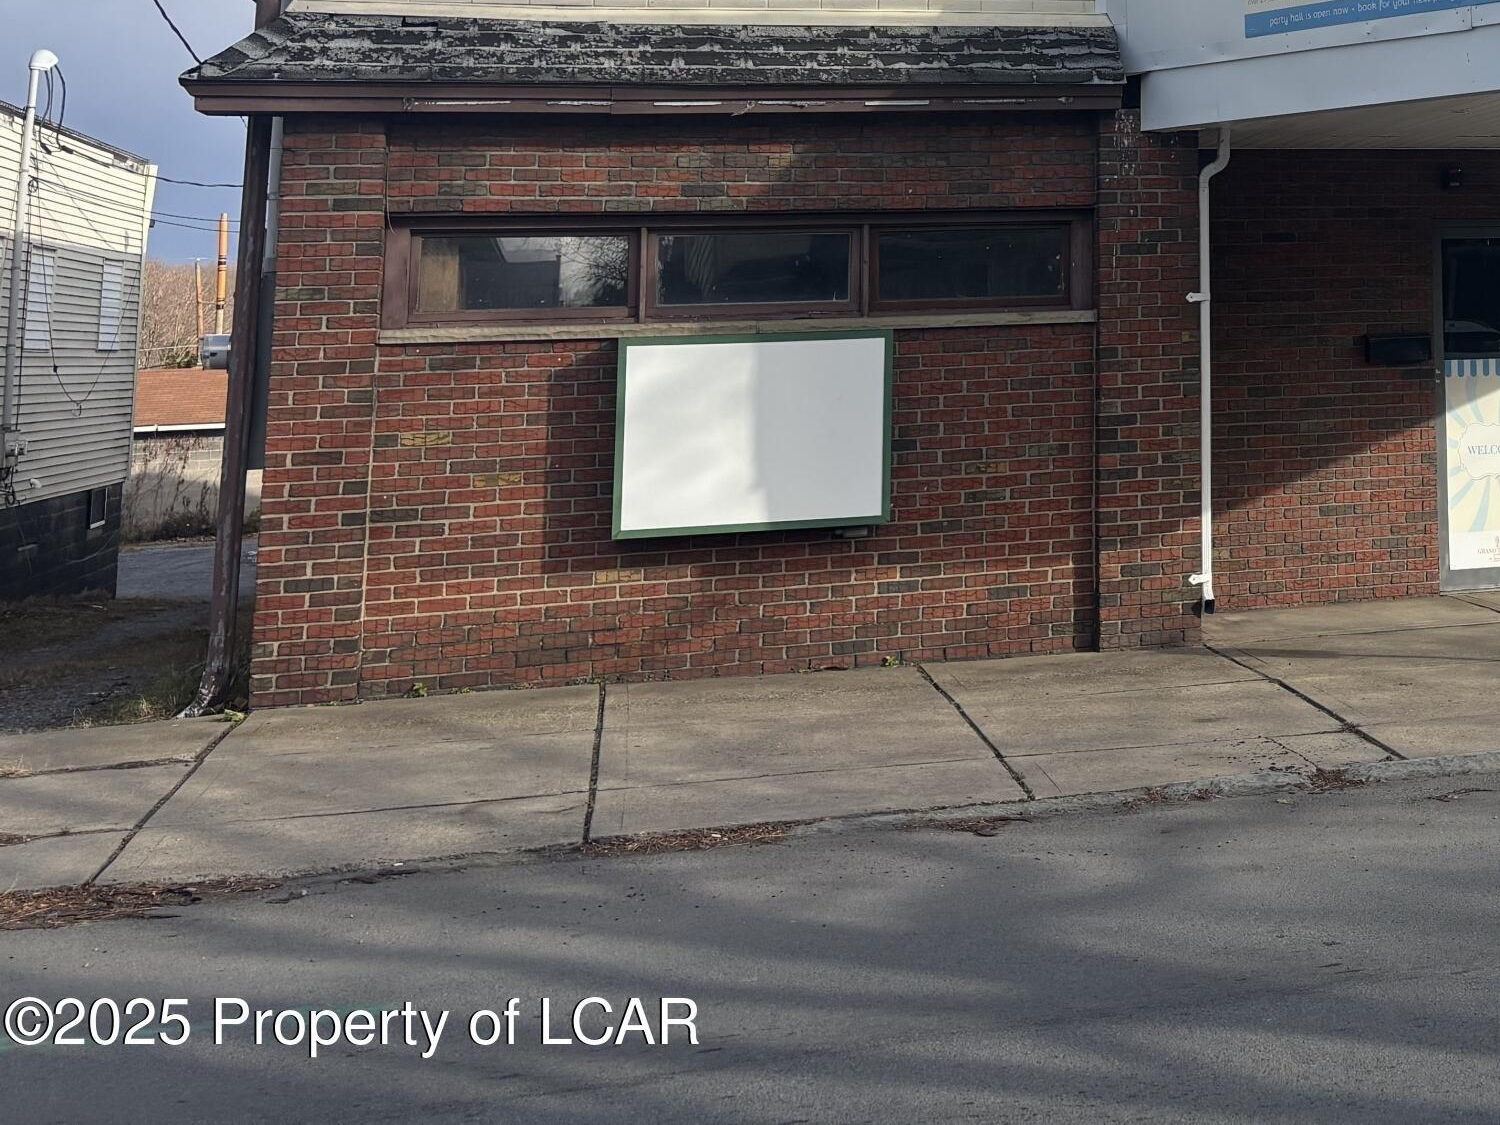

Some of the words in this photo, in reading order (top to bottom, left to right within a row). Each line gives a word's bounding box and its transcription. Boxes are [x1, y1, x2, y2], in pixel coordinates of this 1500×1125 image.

[1269, 15, 1288, 27] party
[1290, 12, 1304, 22] hall
[1305, 11, 1312, 20] is
[1313, 9, 1331, 20] open
[1332, 6, 1349, 16] now
[1357, 2, 1377, 12] book
[1379, 0, 1391, 11] for
